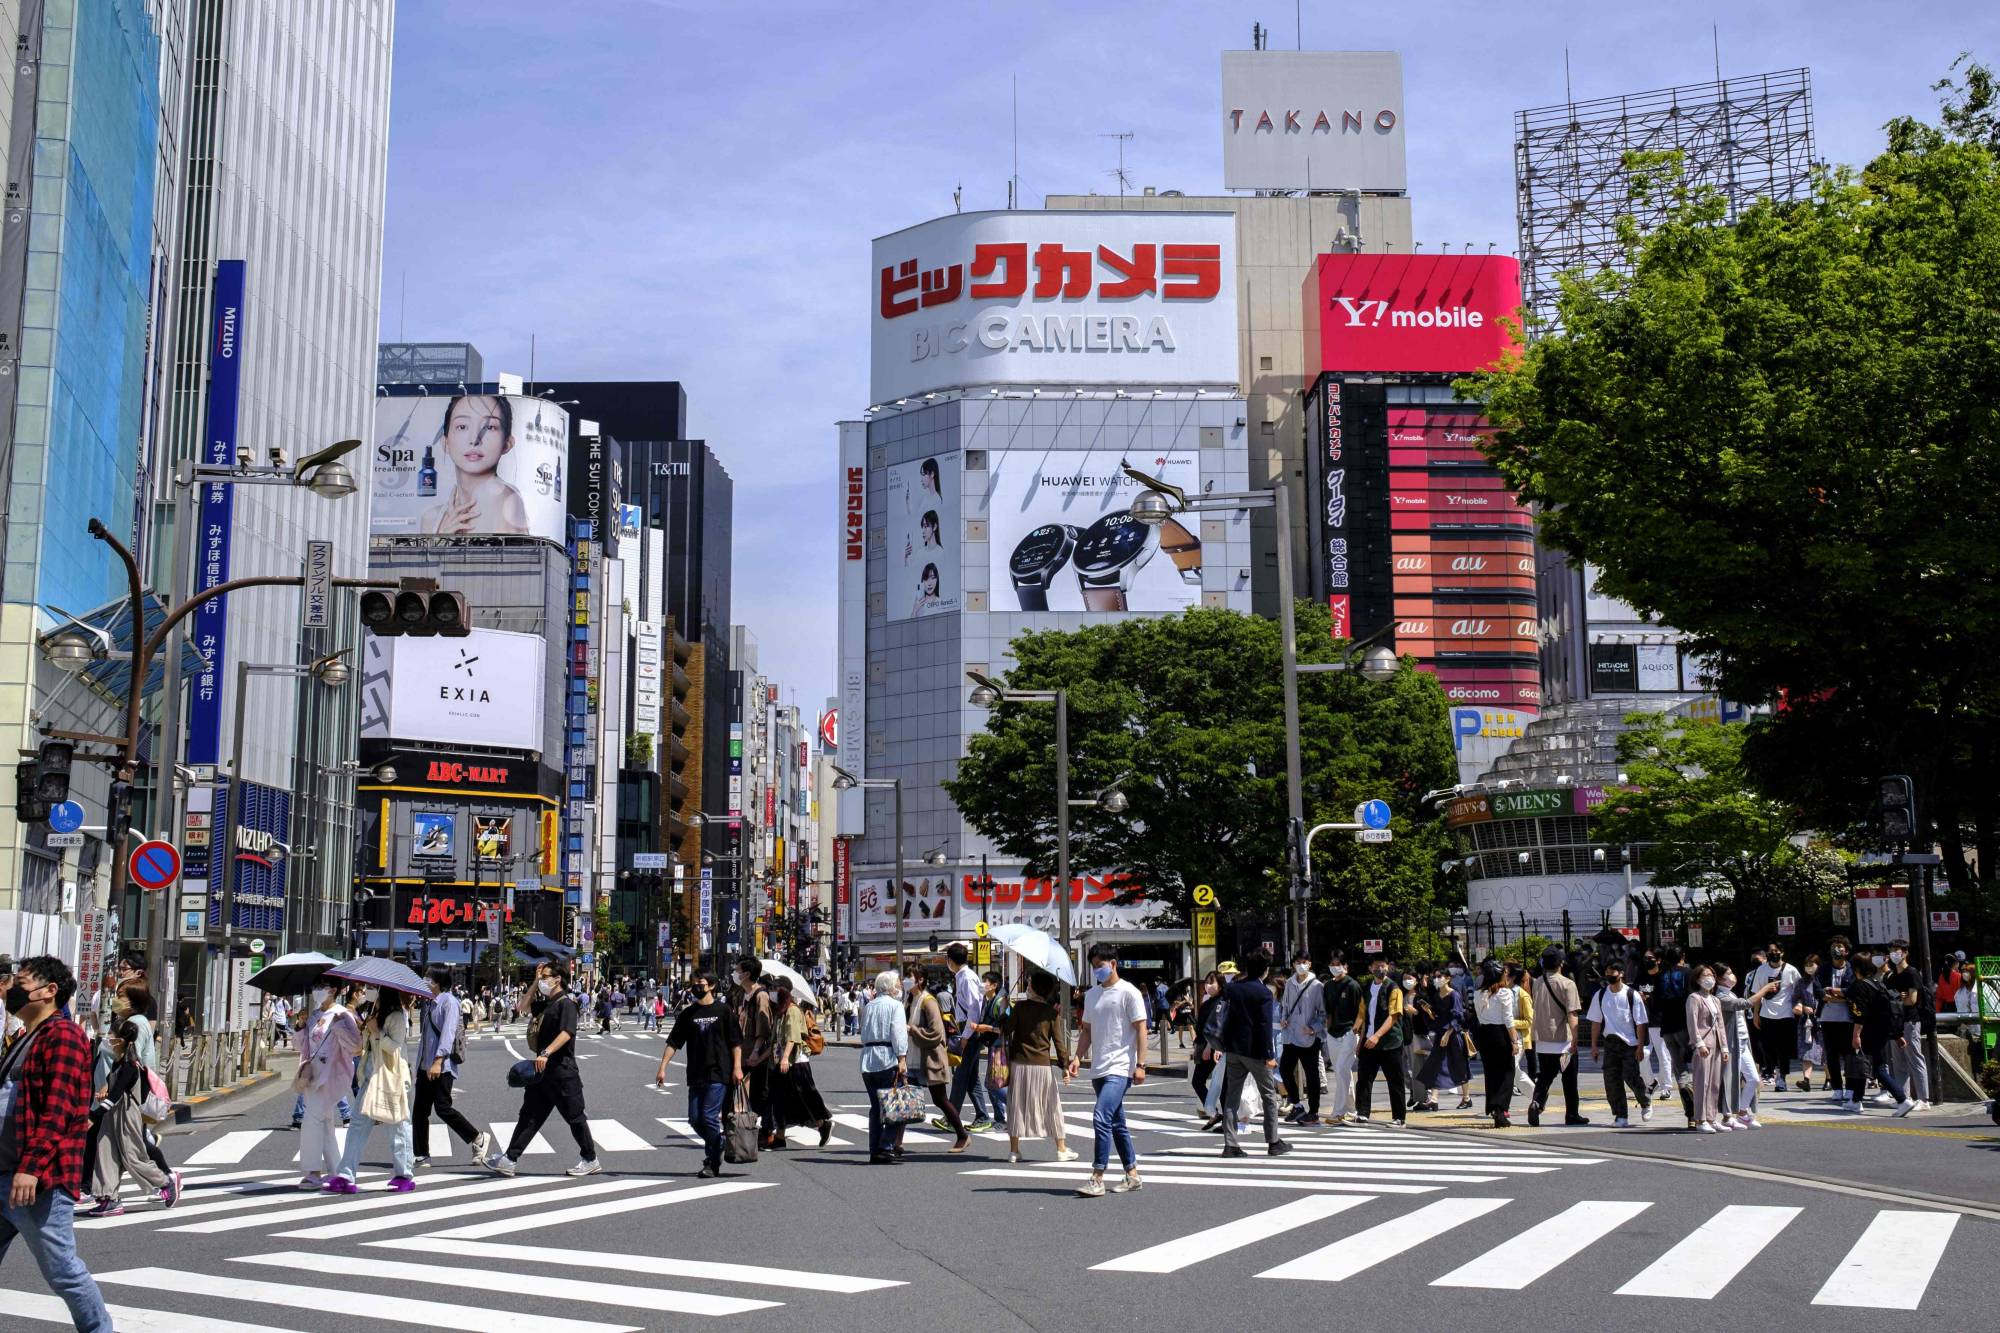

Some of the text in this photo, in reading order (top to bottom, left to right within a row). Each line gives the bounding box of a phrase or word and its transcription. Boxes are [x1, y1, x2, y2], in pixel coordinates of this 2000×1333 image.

[1230, 109, 1396, 130] TAKANO
[880, 243, 1221, 319] ビックカメラ
[1331, 297, 1483, 328] Y! mobile
[222, 307, 236, 358] MIZUHO
[909, 315, 1176, 362] BIC CAMERA
[1328, 383, 1342, 461] ヨドバシカメラ
[377, 444, 414, 467] Spa
[210, 440, 227, 504] みず証券
[536, 467, 552, 481] Spa
[1041, 476, 1138, 487] HUAWEI WATCH
[588, 436, 601, 544] THE SUIT COMPAN
[1328, 469, 1346, 528] ケータイ
[1445, 495, 1488, 505] Y! mobile
[204, 524, 222, 614] みずほ信託行
[1330, 538, 1348, 588] 総合館
[1397, 557, 1426, 570] au
[1451, 556, 1487, 571] au
[309, 544, 326, 624] スクランブル交差点
[1399, 621, 1428, 634] au
[1451, 619, 1491, 636] au
[1642, 663, 1674, 671] AQUOS
[440, 686, 490, 703] EXIA
[1449, 687, 1500, 699] docomo
[1455, 709, 1482, 751] P
[427, 762, 508, 784] ABC-MART
[1508, 793, 1561, 810] MEN'S
[49, 836, 82, 846] 歩行者優先
[860, 891, 878, 912] 5G
[1198, 888, 1210, 901] 2
[1549, 881, 1616, 911] DAYS
[237, 967, 246, 1009] INFORMATION
